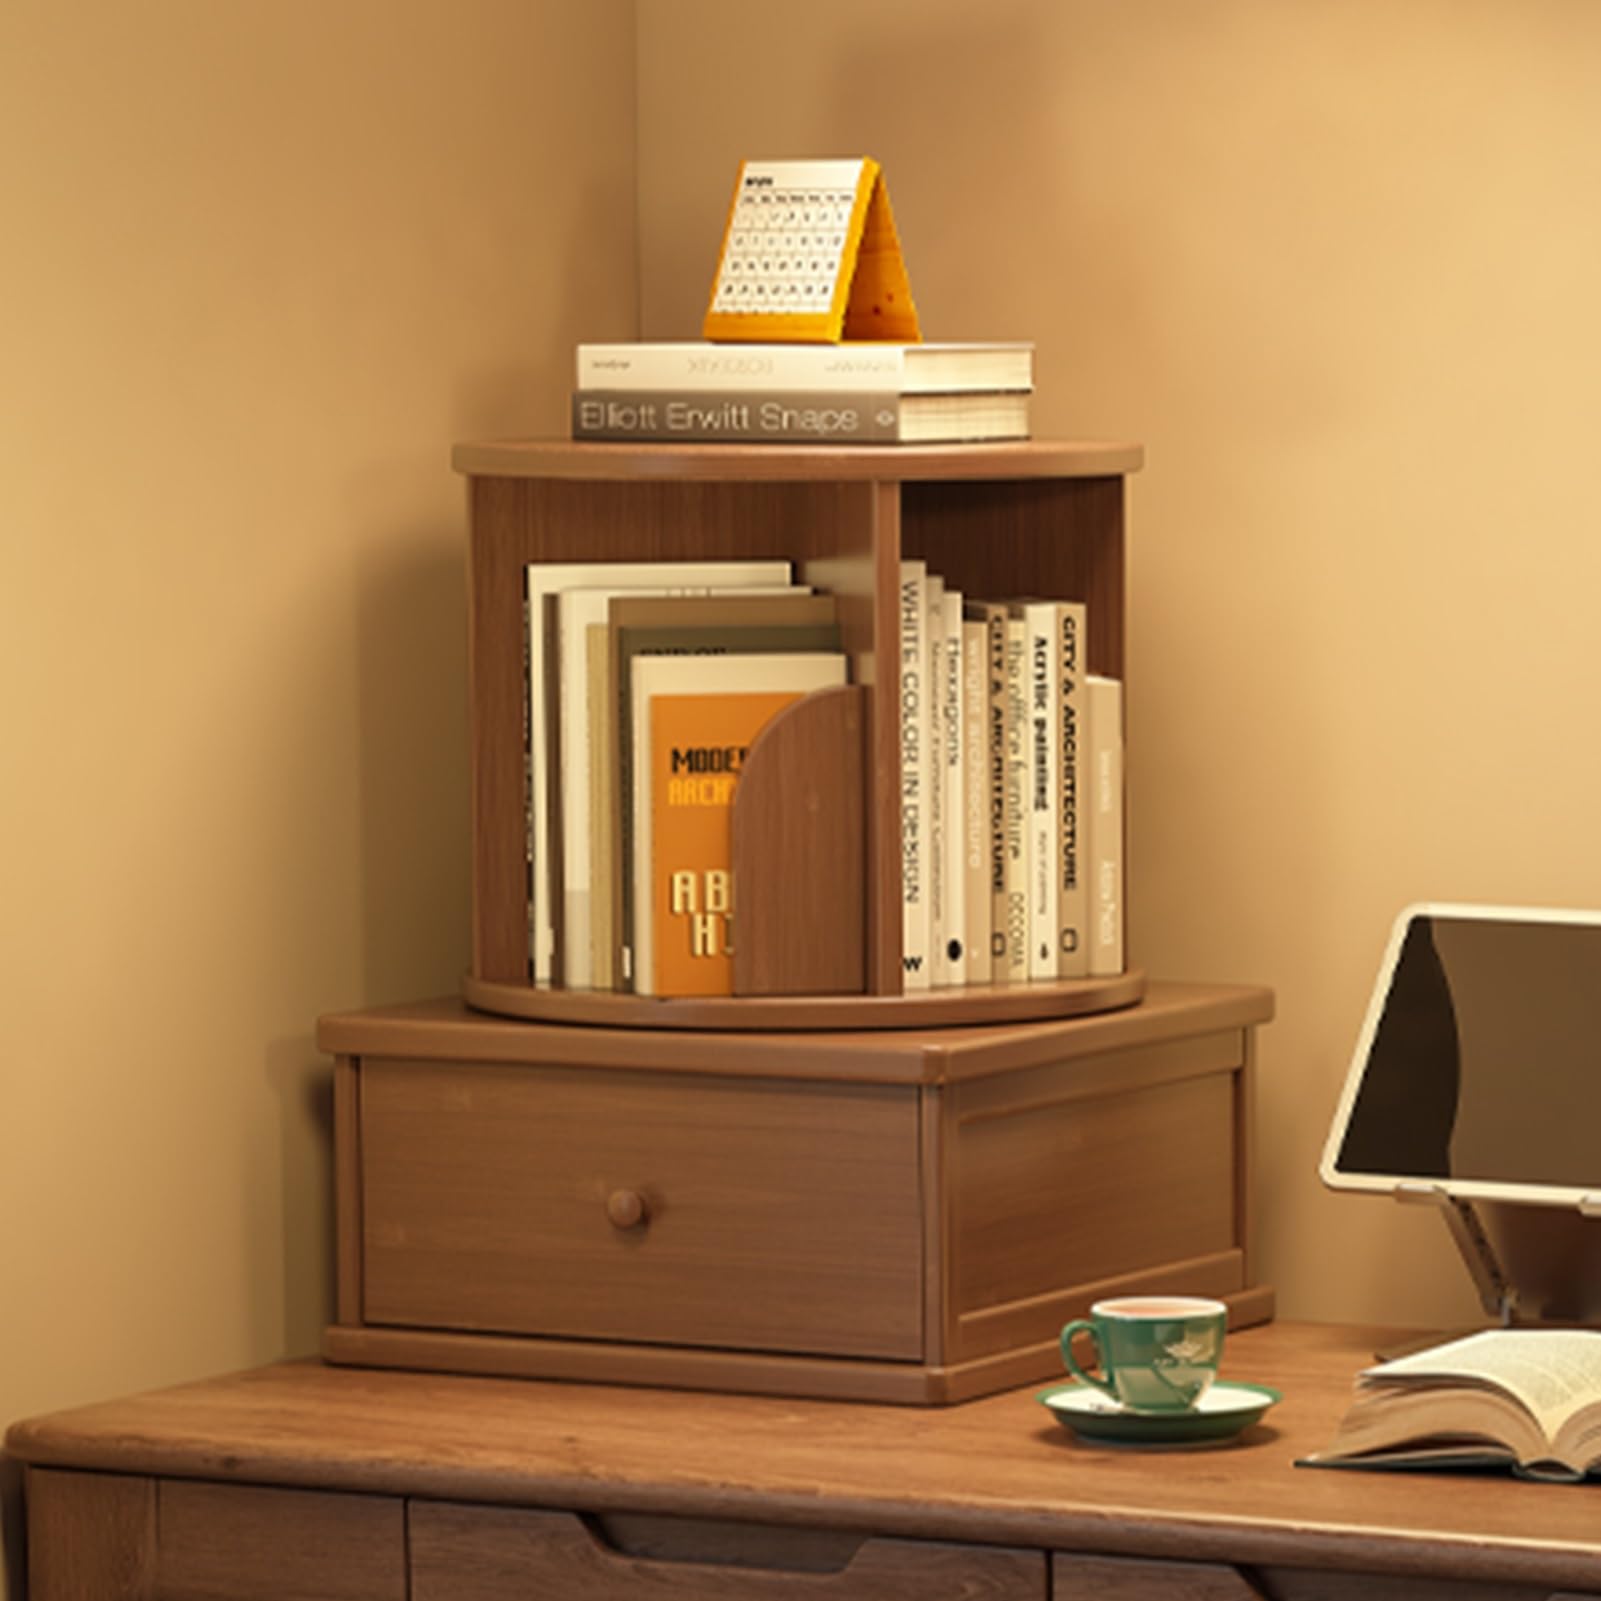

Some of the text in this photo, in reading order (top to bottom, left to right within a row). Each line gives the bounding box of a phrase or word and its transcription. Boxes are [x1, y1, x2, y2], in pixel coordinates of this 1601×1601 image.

[580, 402, 859, 434] Elliott Erwitt Snaps
[991, 615, 1004, 671] CITY
[1062, 616, 1076, 673] CITY
[901, 580, 920, 903] WHITE COLOR IN DESIGN
[943, 636, 960, 766] Hexagons
[991, 706, 1005, 892] ARCHITECTURE
[1062, 705, 1077, 890] ARCHITECTURE
[673, 870, 697, 913] A
